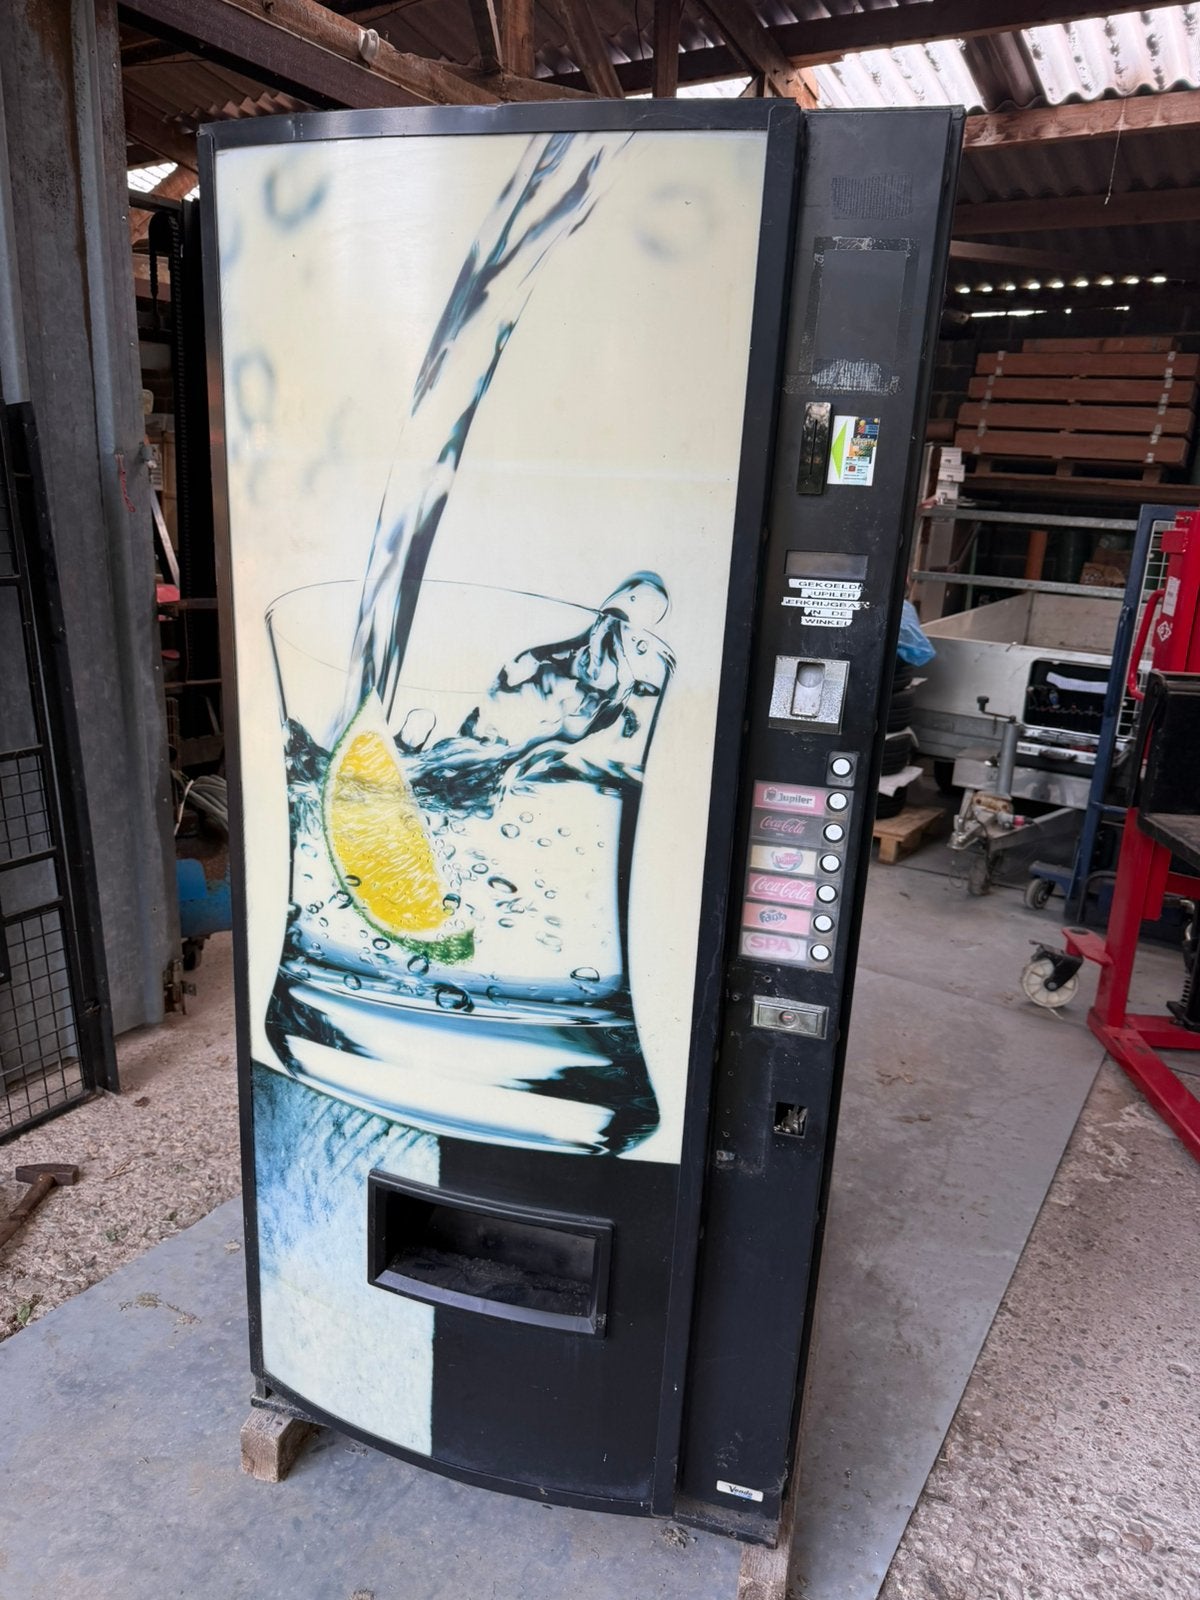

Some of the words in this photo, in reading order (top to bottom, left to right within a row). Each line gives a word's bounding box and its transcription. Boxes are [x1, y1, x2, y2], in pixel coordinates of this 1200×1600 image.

[778, 793, 813, 804] Jupiler
[759, 910, 787, 923] Fanta
[750, 935, 793, 952] SPA
[729, 1485, 753, 1496] Vendo
